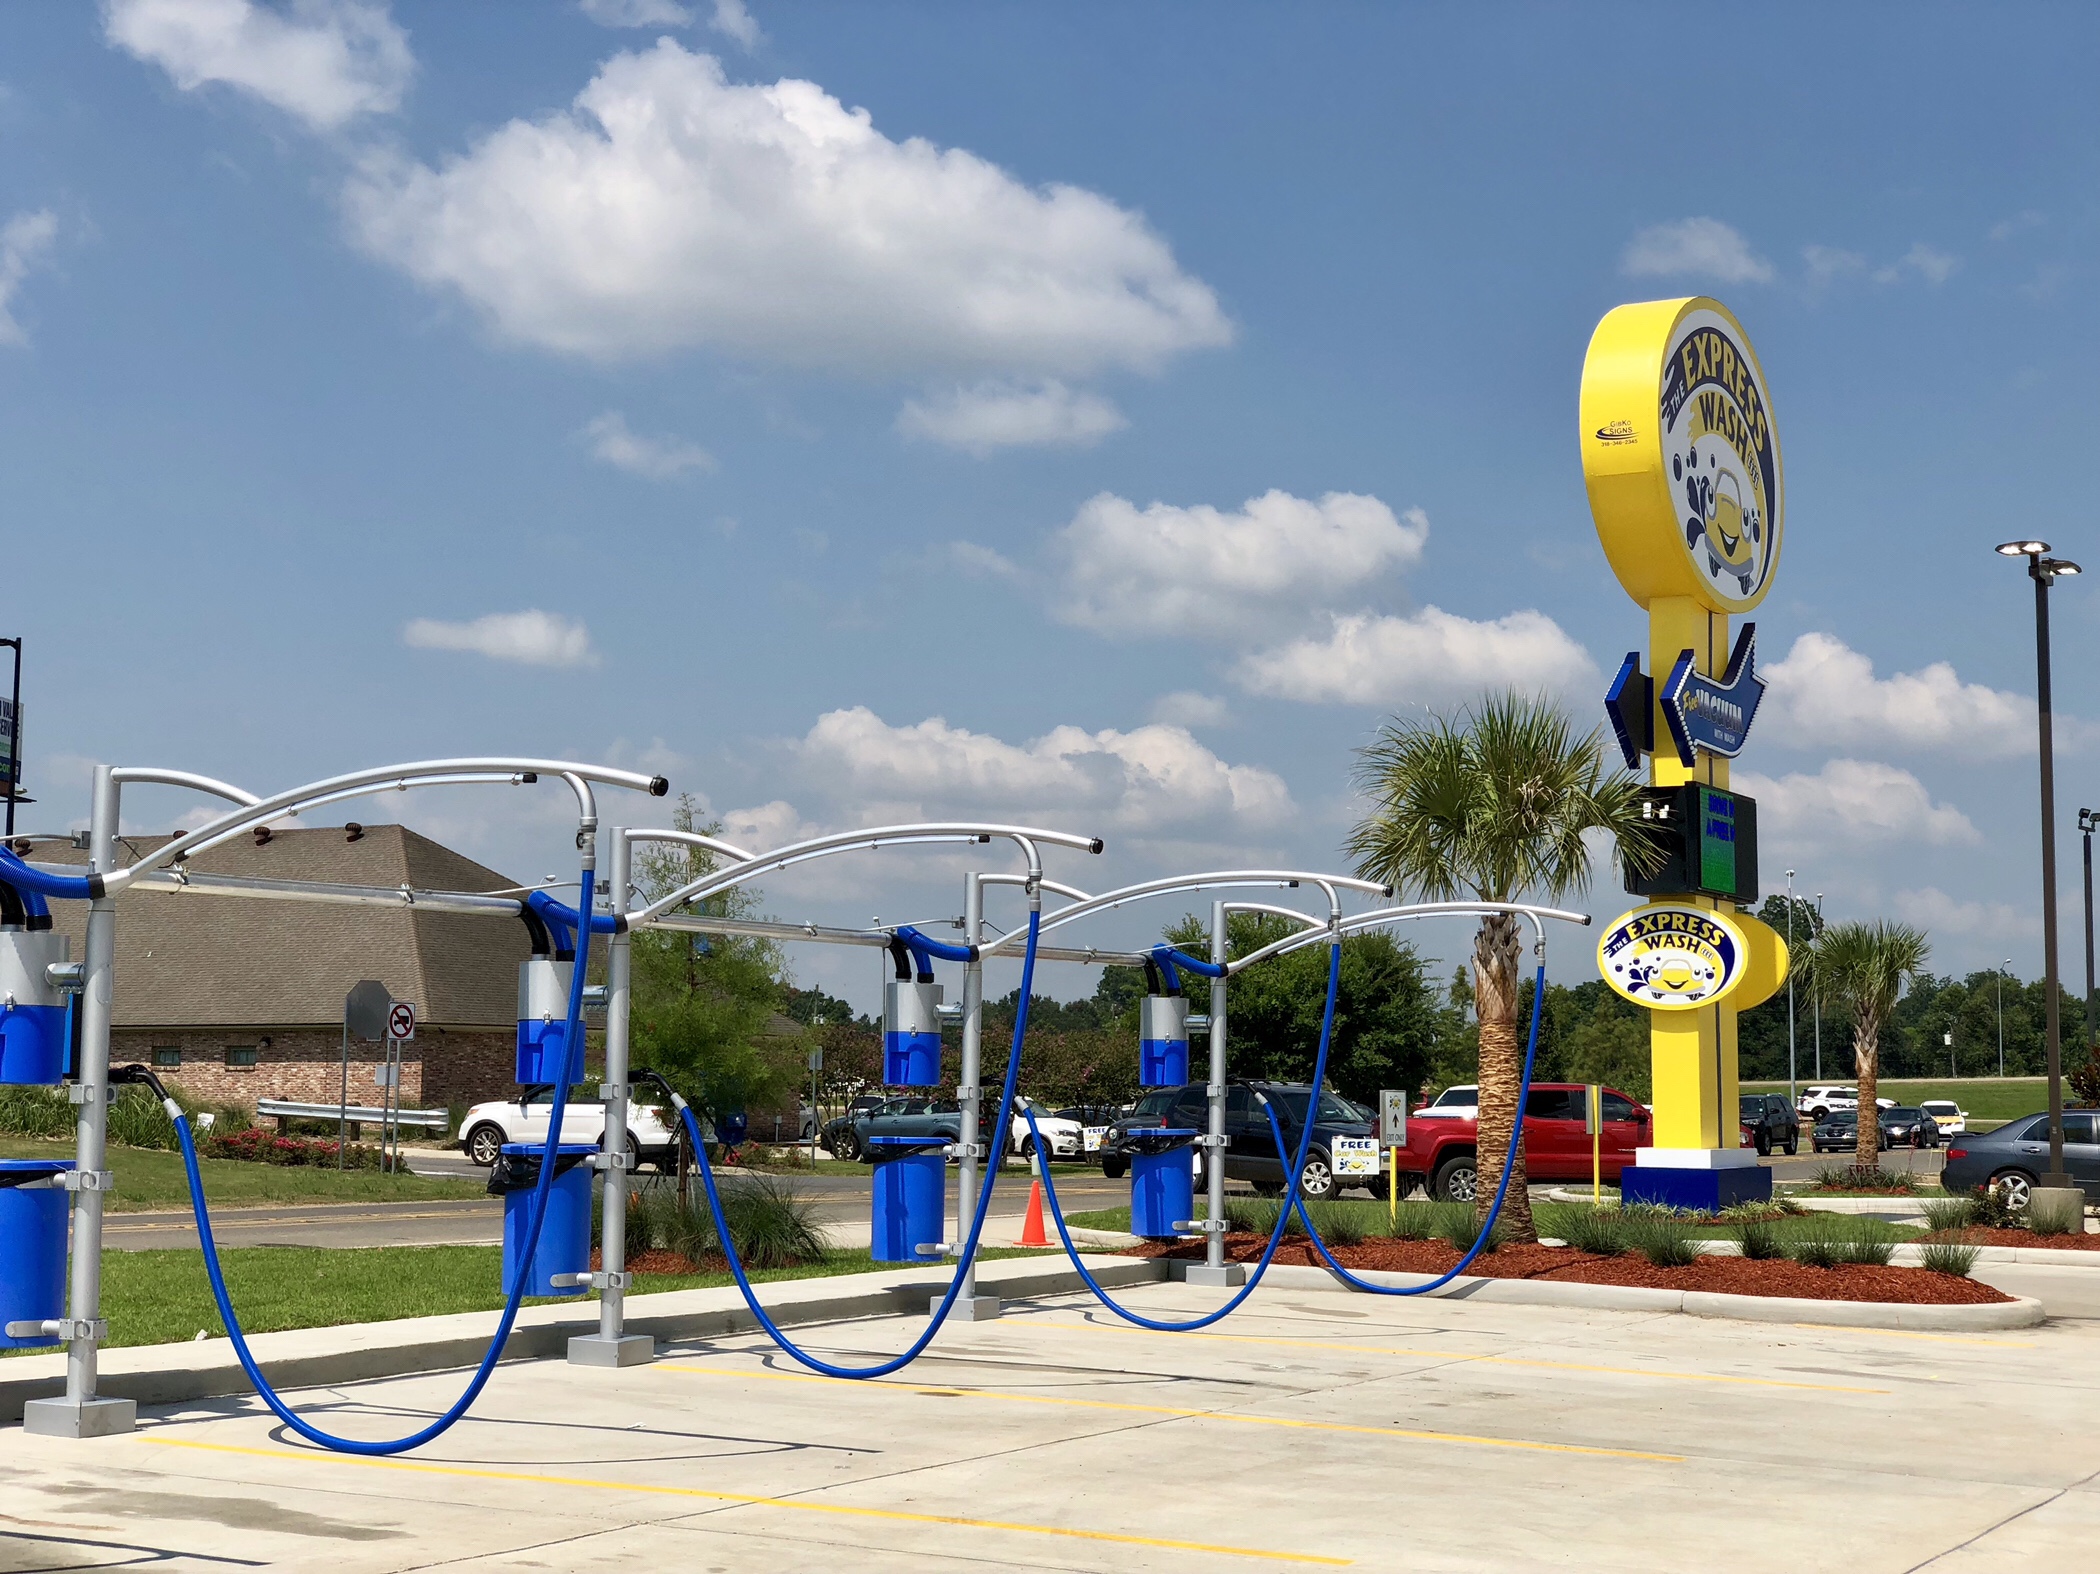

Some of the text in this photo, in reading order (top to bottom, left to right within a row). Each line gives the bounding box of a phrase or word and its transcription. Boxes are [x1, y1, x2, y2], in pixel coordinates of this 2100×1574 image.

[1670, 333, 1766, 452] THE EXPRESS
[1610, 427, 1633, 435] SIGNS
[1698, 392, 1749, 465] WASH
[1696, 689, 1743, 734] VACUUM
[1613, 913, 1725, 952] THE EXPRESS
[1643, 934, 1701, 953] WASH
[1341, 1141, 1371, 1149] FREE
